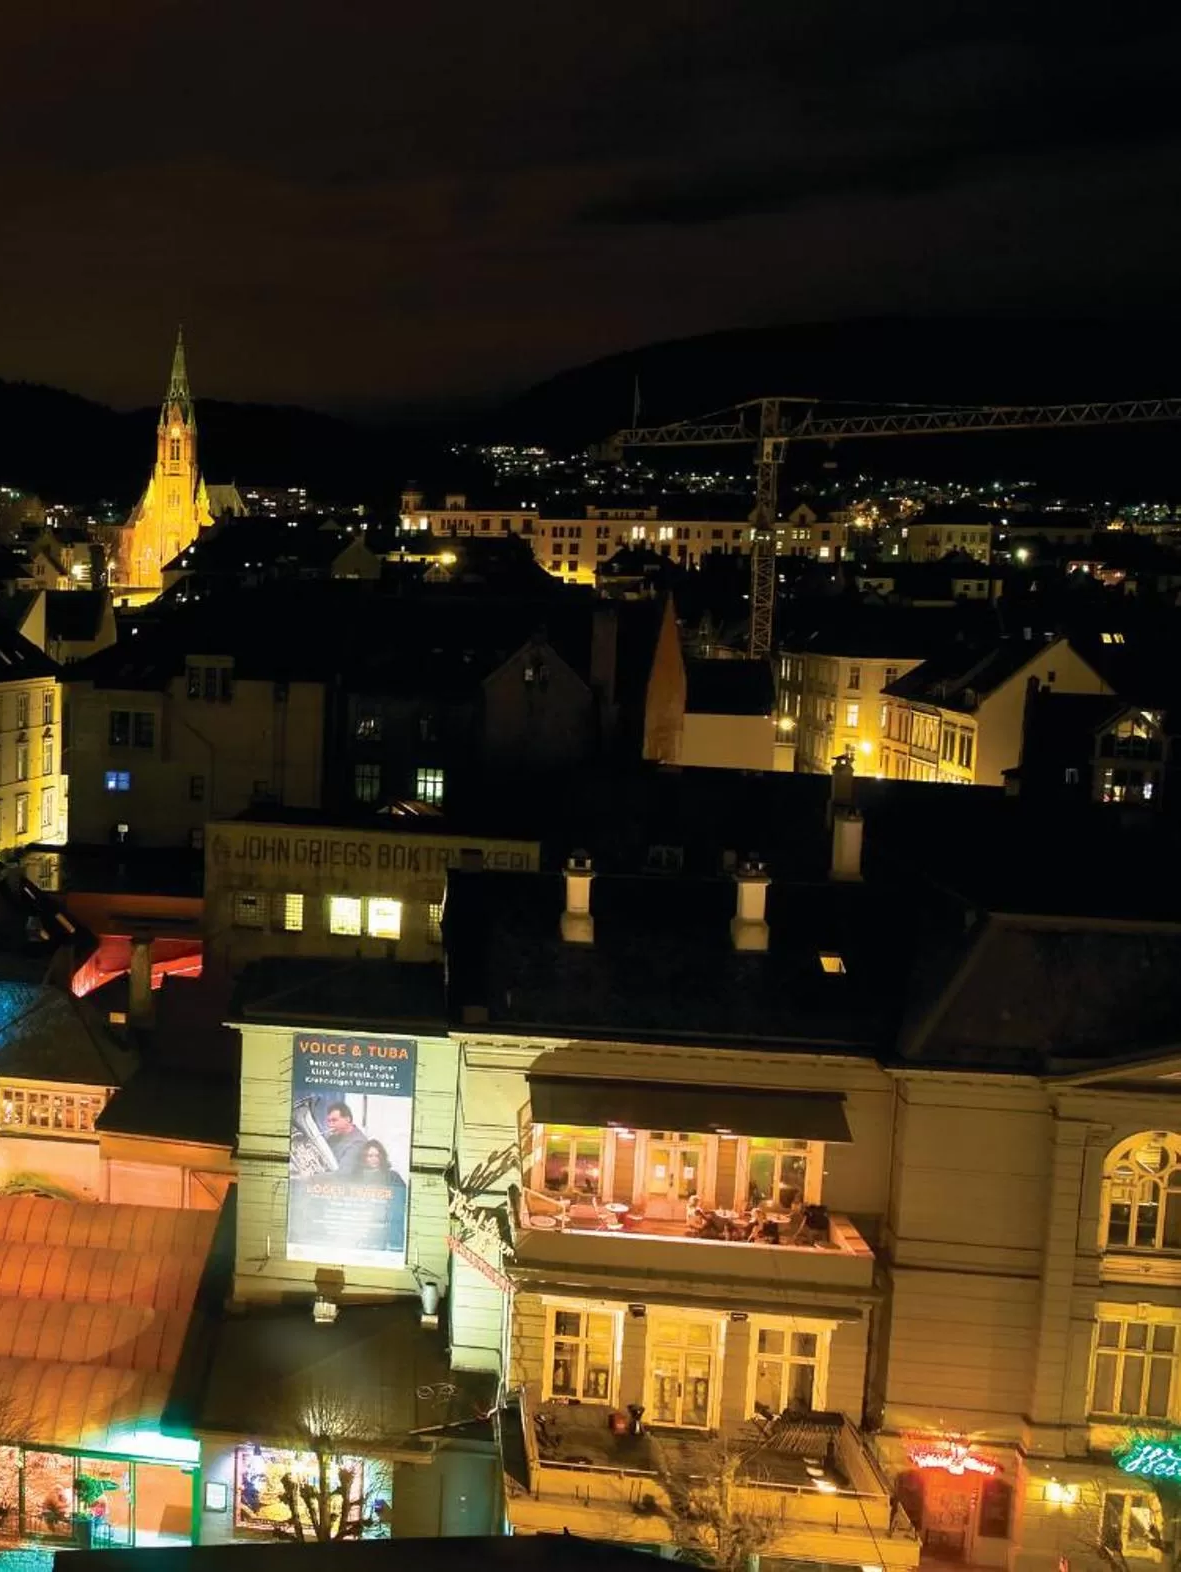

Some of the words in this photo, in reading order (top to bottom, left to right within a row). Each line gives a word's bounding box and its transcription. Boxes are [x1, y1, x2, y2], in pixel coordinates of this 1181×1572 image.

[234, 835, 290, 862] JOHN
[293, 838, 372, 868] GRIEGS
[299, 1041, 347, 1056] VOICE
[351, 1044, 362, 1057] &
[367, 1045, 409, 1060] TUBA
